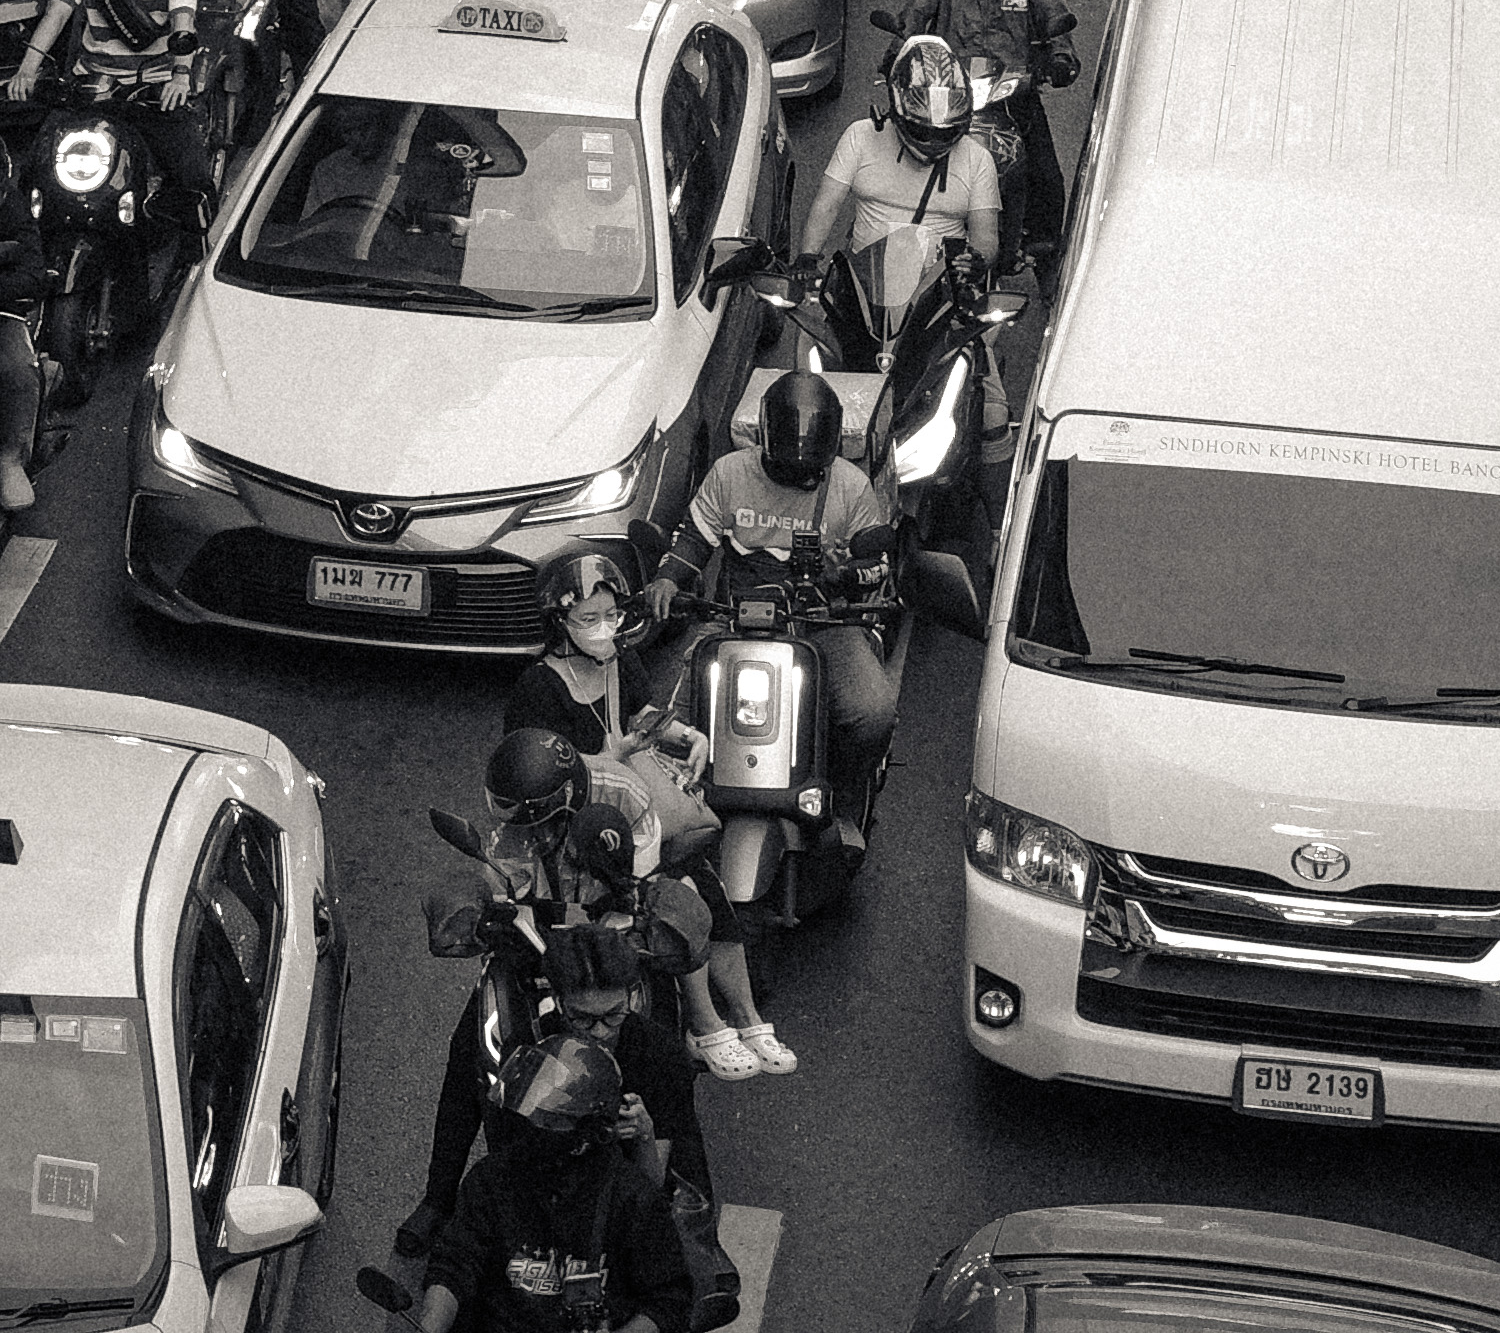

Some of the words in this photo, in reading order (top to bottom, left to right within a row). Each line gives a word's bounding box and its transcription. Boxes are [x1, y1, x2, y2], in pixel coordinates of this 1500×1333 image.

[479, 7, 524, 33] TAXI
[1157, 436, 1263, 456] SINDHORN
[1268, 442, 1372, 466] KEMPINSKI
[1378, 452, 1444, 474] HOTEL
[374, 570, 413, 593] 777
[1307, 1072, 1369, 1099] 2139
